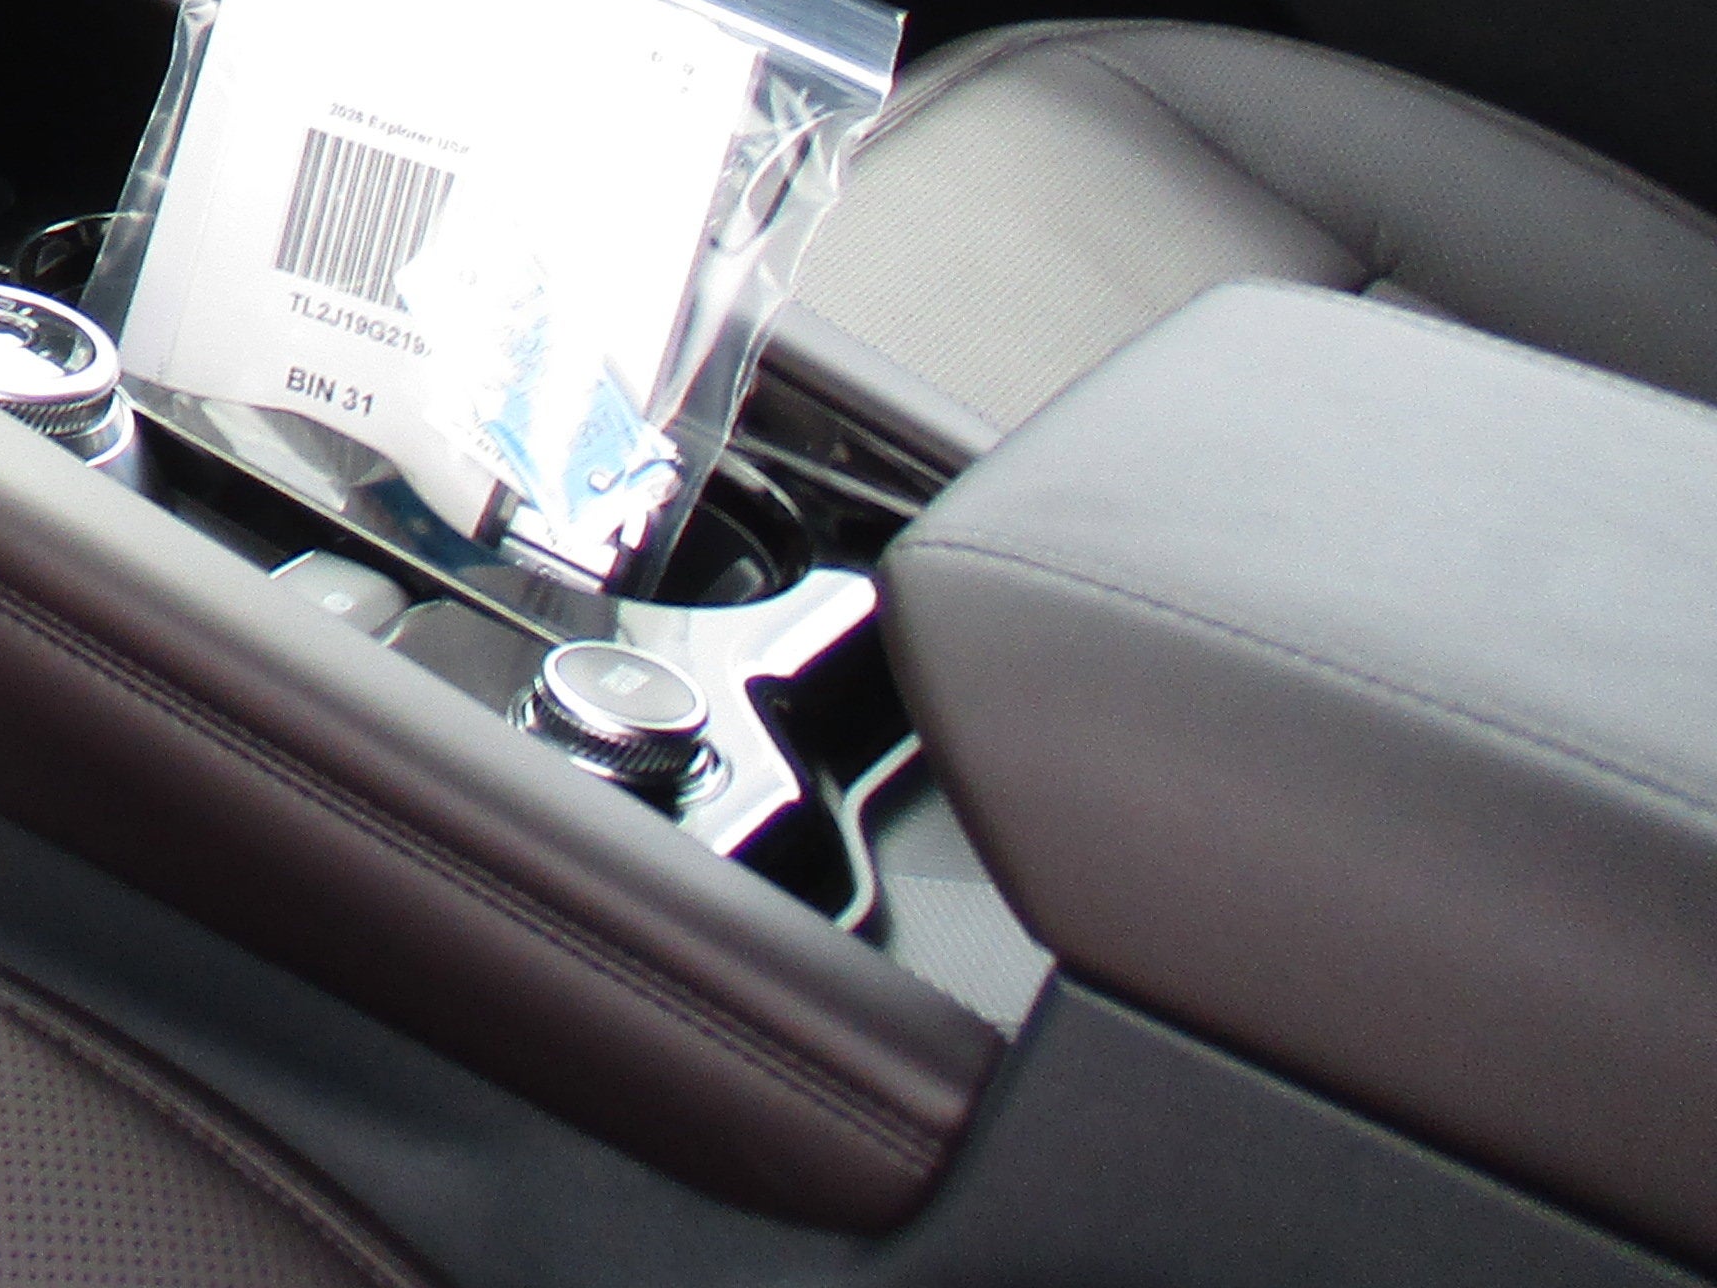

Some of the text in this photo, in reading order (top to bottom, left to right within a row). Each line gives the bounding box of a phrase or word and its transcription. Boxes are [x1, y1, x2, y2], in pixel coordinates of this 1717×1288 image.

[289, 290, 433, 359] TL2J19G219
[285, 365, 374, 418] BIN 31
